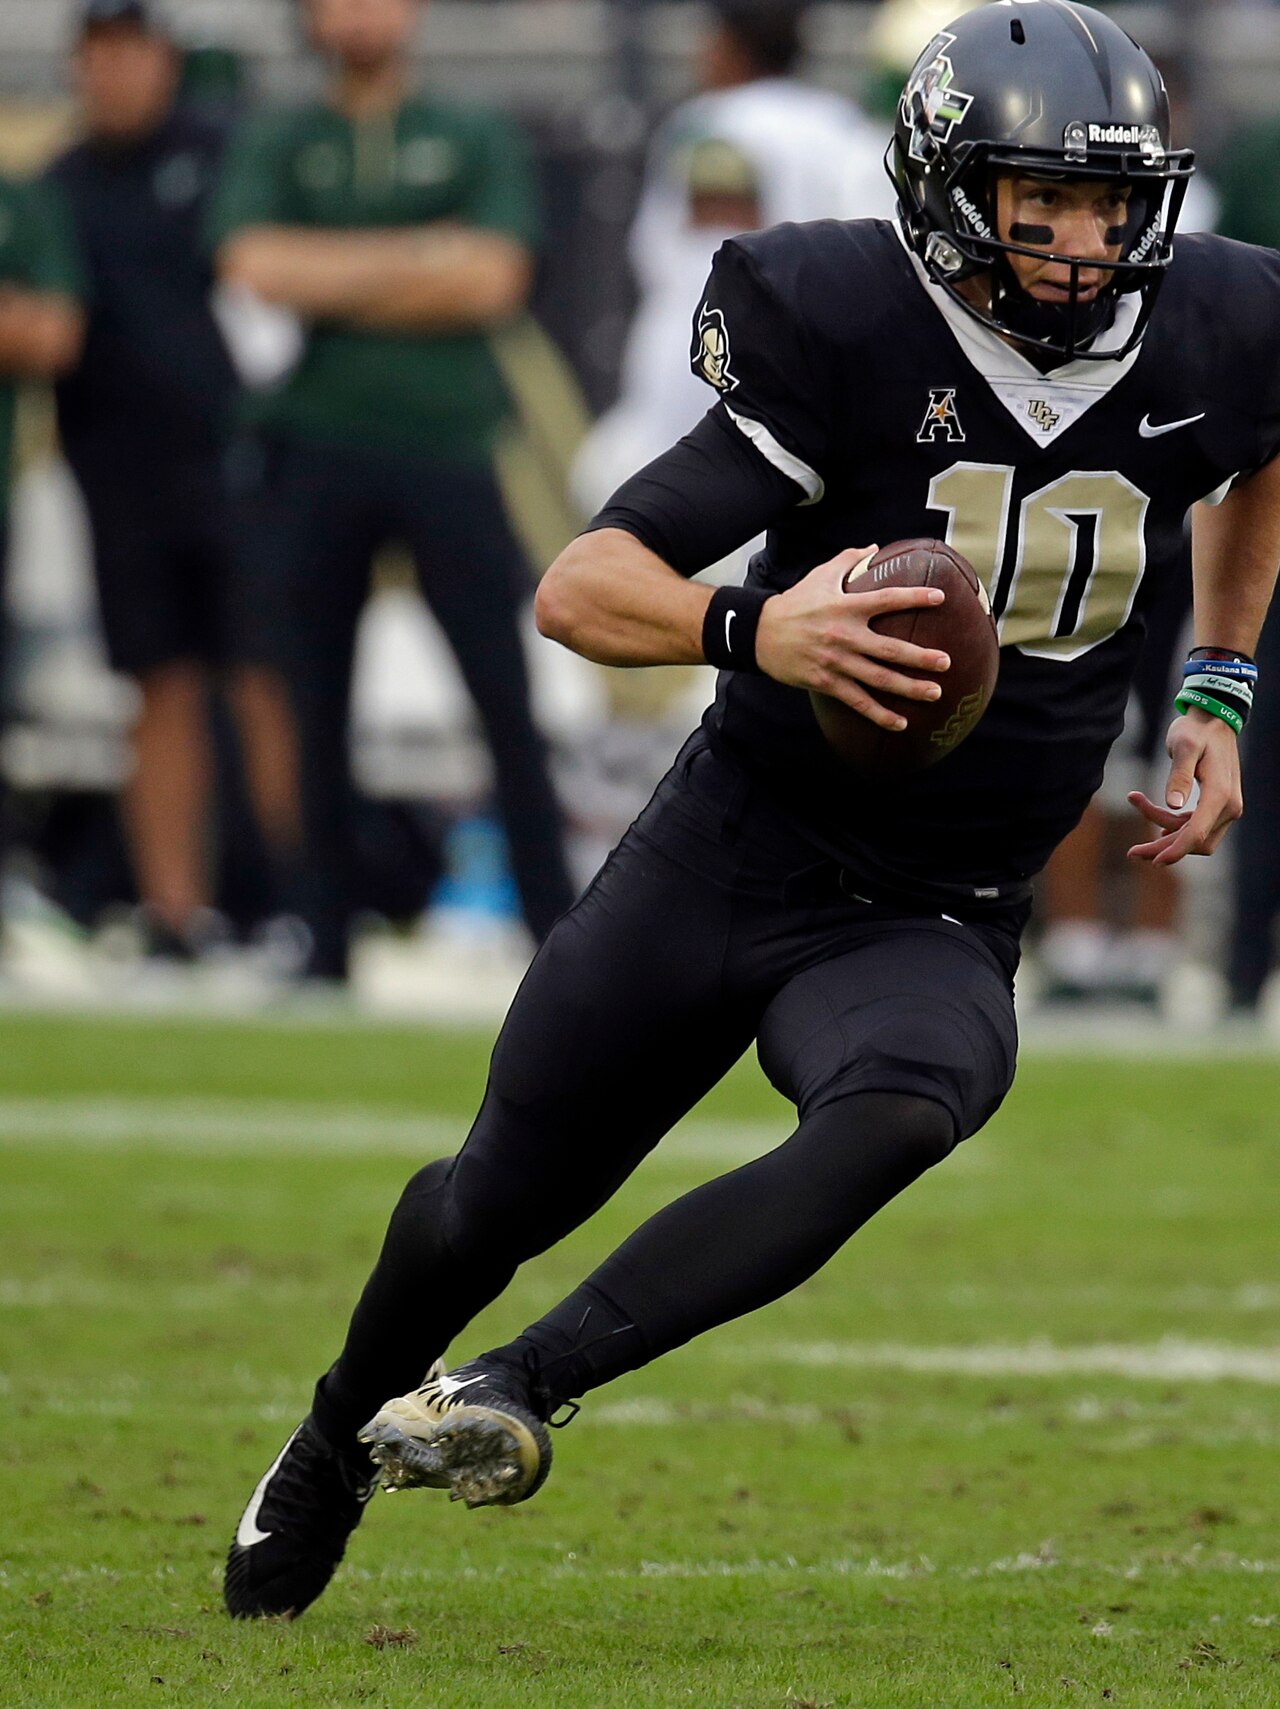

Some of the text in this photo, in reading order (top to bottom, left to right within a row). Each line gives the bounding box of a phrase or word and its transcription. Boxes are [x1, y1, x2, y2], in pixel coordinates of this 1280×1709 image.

[1088, 123, 1139, 144] Riddell
[1028, 399, 1060, 432] UCF
[925, 460, 1151, 662] 10
